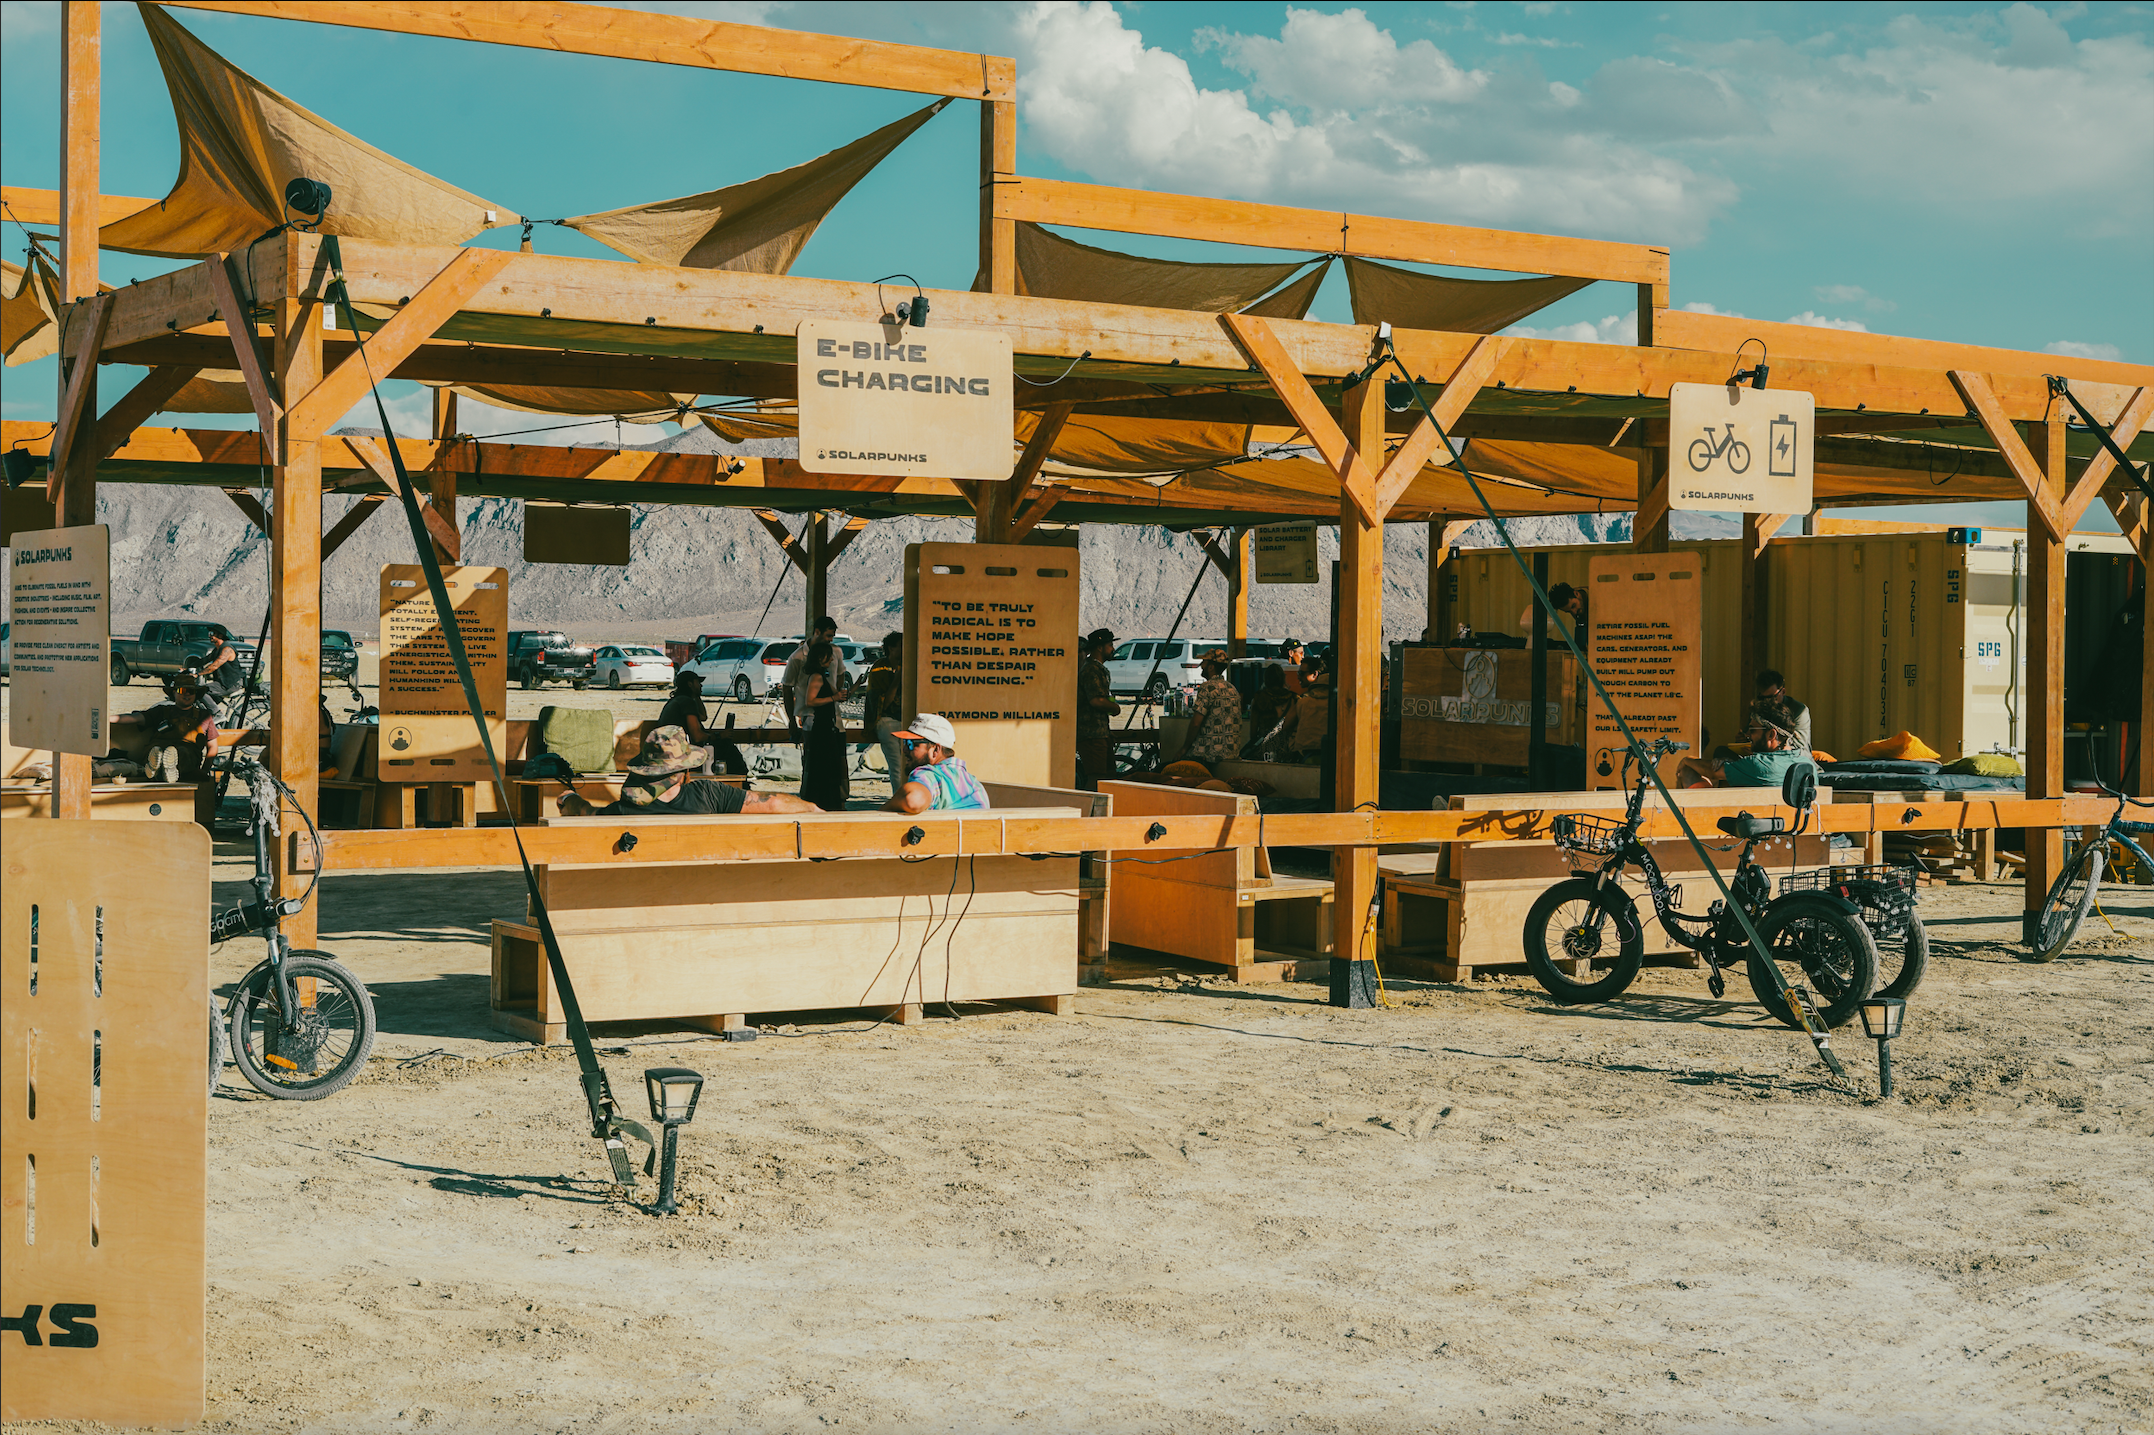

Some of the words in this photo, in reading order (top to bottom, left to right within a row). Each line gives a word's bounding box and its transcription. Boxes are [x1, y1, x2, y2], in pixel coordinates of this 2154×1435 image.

[817, 338, 926, 363] E-BIKE
[817, 369, 989, 396] CHARGING
[829, 450, 927, 462] SOLARPUNKS
[1688, 491, 1754, 501] SOLARPUNKS
[21, 547, 71, 564] SOLARPUNKS
[1947, 570, 1959, 602] SPG
[967, 603, 984, 612] BE
[989, 604, 1034, 612] TRULY
[932, 617, 994, 626] RADICAL
[999, 618, 1011, 627] IS
[1016, 618, 1036, 627] TO
[932, 632, 971, 640] MAKE
[976, 632, 1015, 641] HOPE
[1009, 648, 1064, 656] RATHER
[1978, 642, 2001, 657] SPG
[932, 661, 972, 670] THAN
[977, 662, 1036, 670] DESPAIR
[1401, 697, 1560, 726] SOLARPUNS
